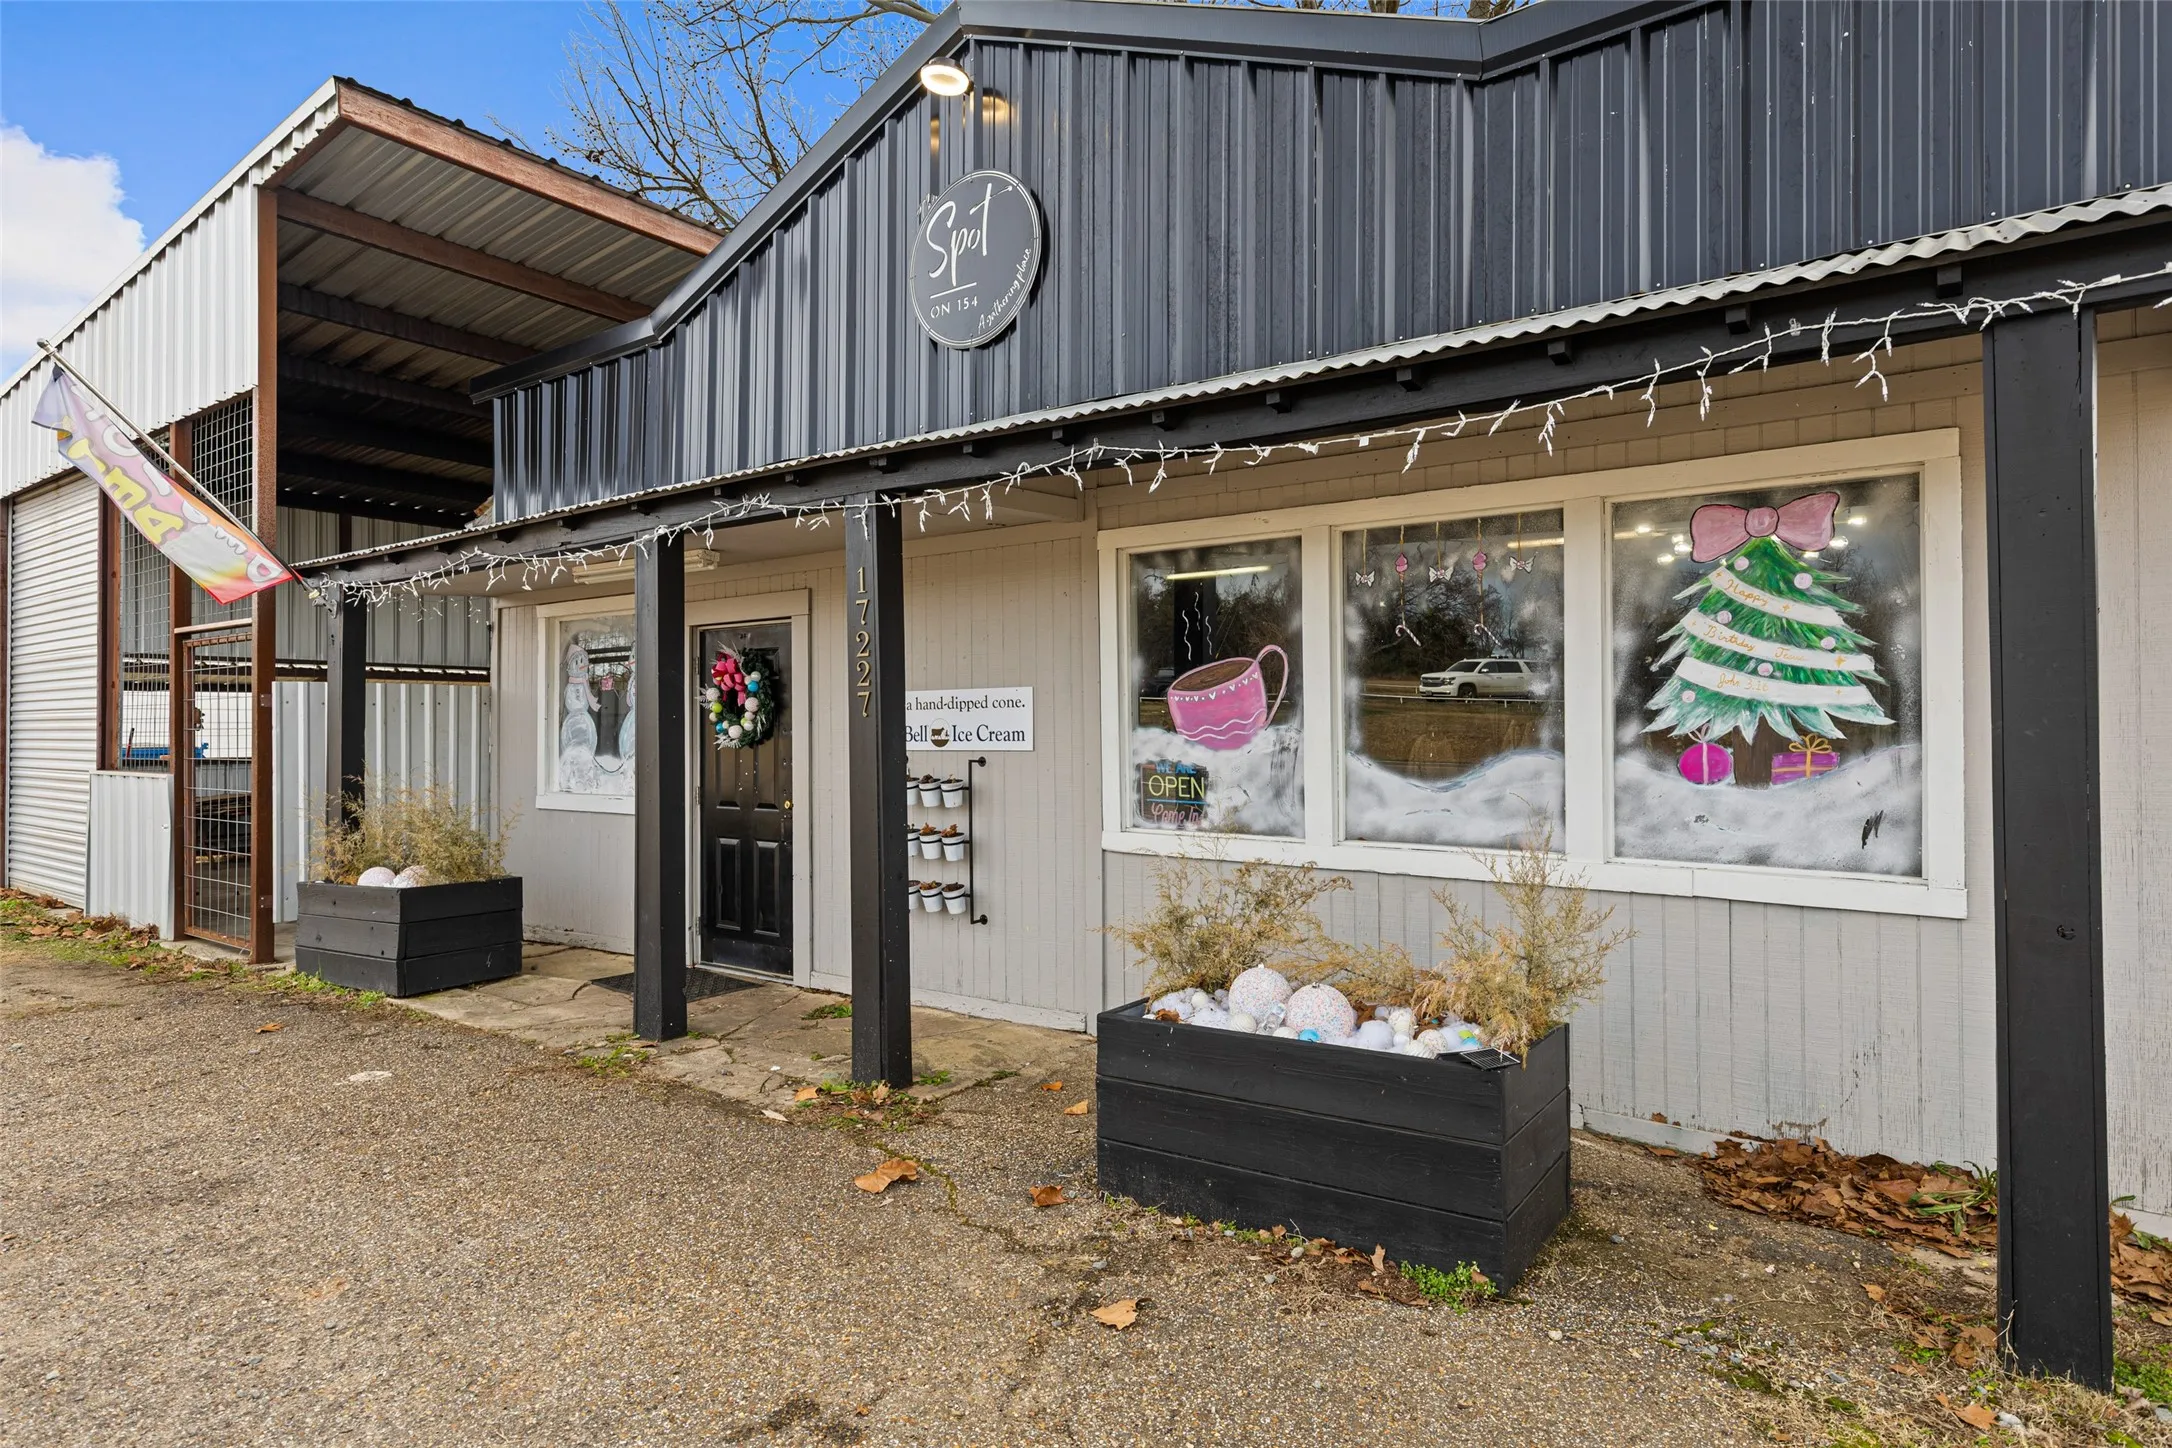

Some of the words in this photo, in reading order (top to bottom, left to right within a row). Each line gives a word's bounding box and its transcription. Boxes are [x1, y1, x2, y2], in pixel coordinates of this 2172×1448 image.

[926, 182, 1013, 287] Spot
[1016, 248, 1032, 283] place
[930, 302, 950, 319] ON
[957, 296, 978, 312] 154
[1725, 578, 1769, 606] Happy
[855, 566, 872, 718] 17227
[1703, 624, 1757, 652] Birthday
[1717, 672, 1741, 689] John
[906, 702, 912, 710] a
[915, 695, 988, 712] hand-dipped
[992, 698, 1025, 709] cone.
[905, 725, 928, 742] Bell
[952, 725, 973, 742] Ice
[976, 724, 1026, 742] Cream
[1155, 761, 1172, 774] WE
[1175, 761, 1197, 774] ARE
[1149, 775, 1205, 799] OPEN
